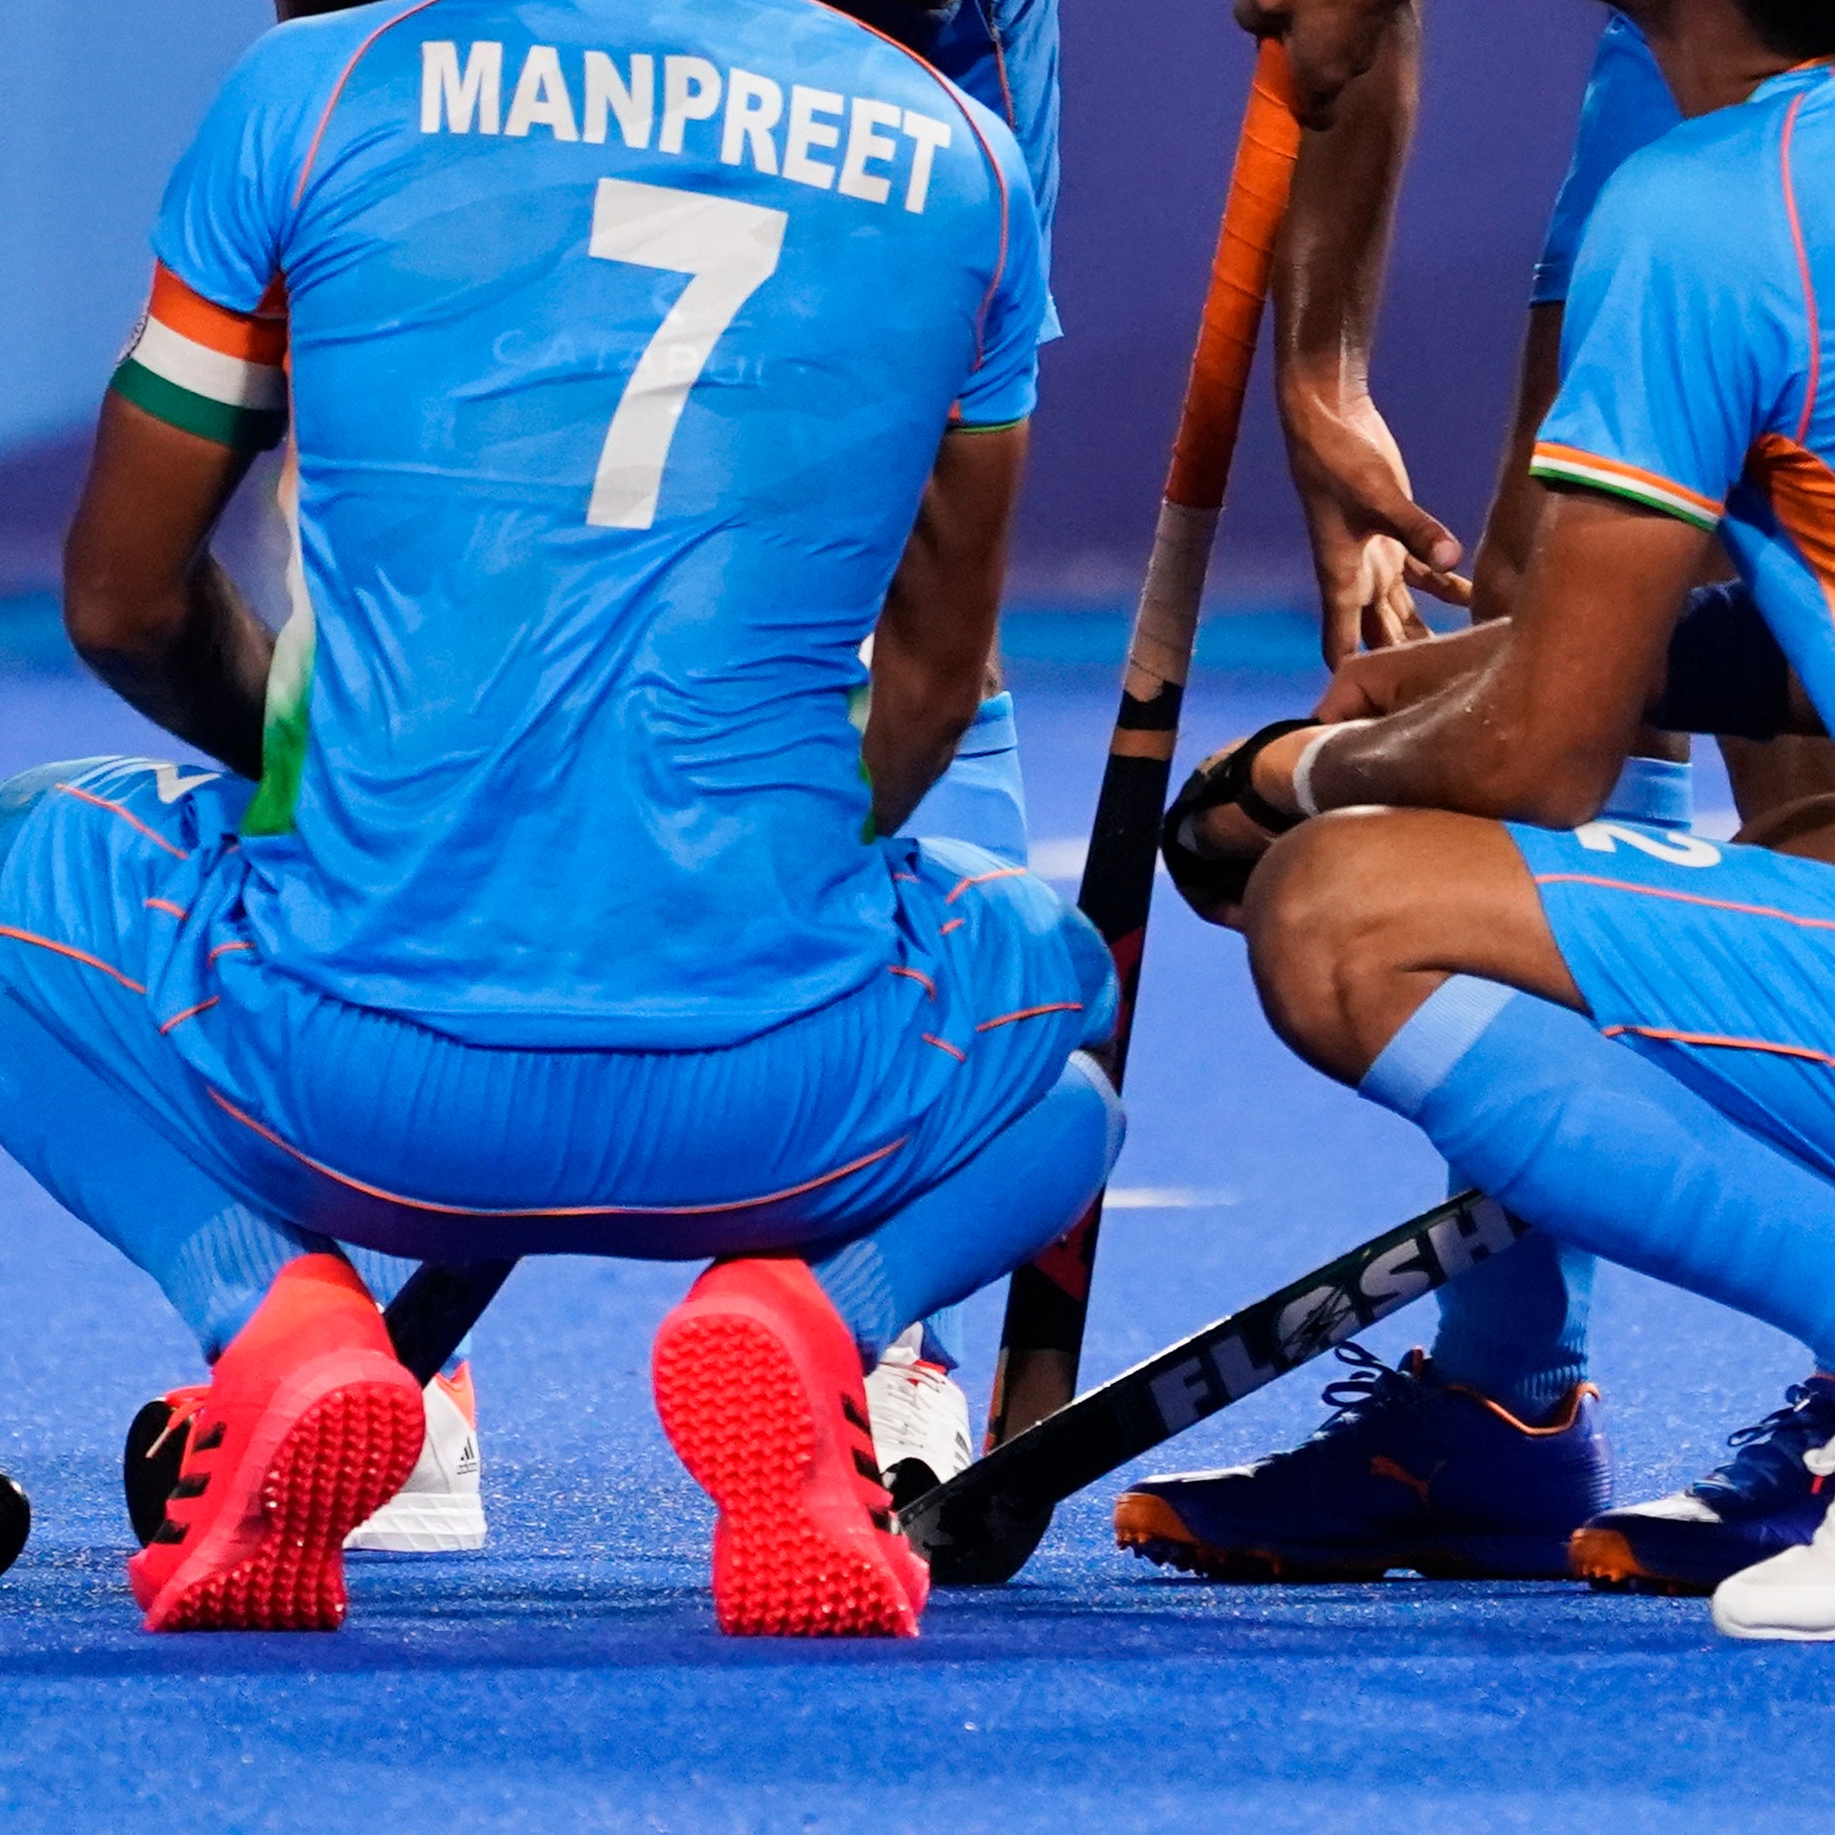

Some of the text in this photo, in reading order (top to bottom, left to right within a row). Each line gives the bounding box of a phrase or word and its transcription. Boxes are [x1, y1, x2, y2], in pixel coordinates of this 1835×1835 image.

[420, 41, 952, 214] MANPREET
[586, 177, 789, 530] 7
[1150, 1198, 1519, 1437] FLASH
